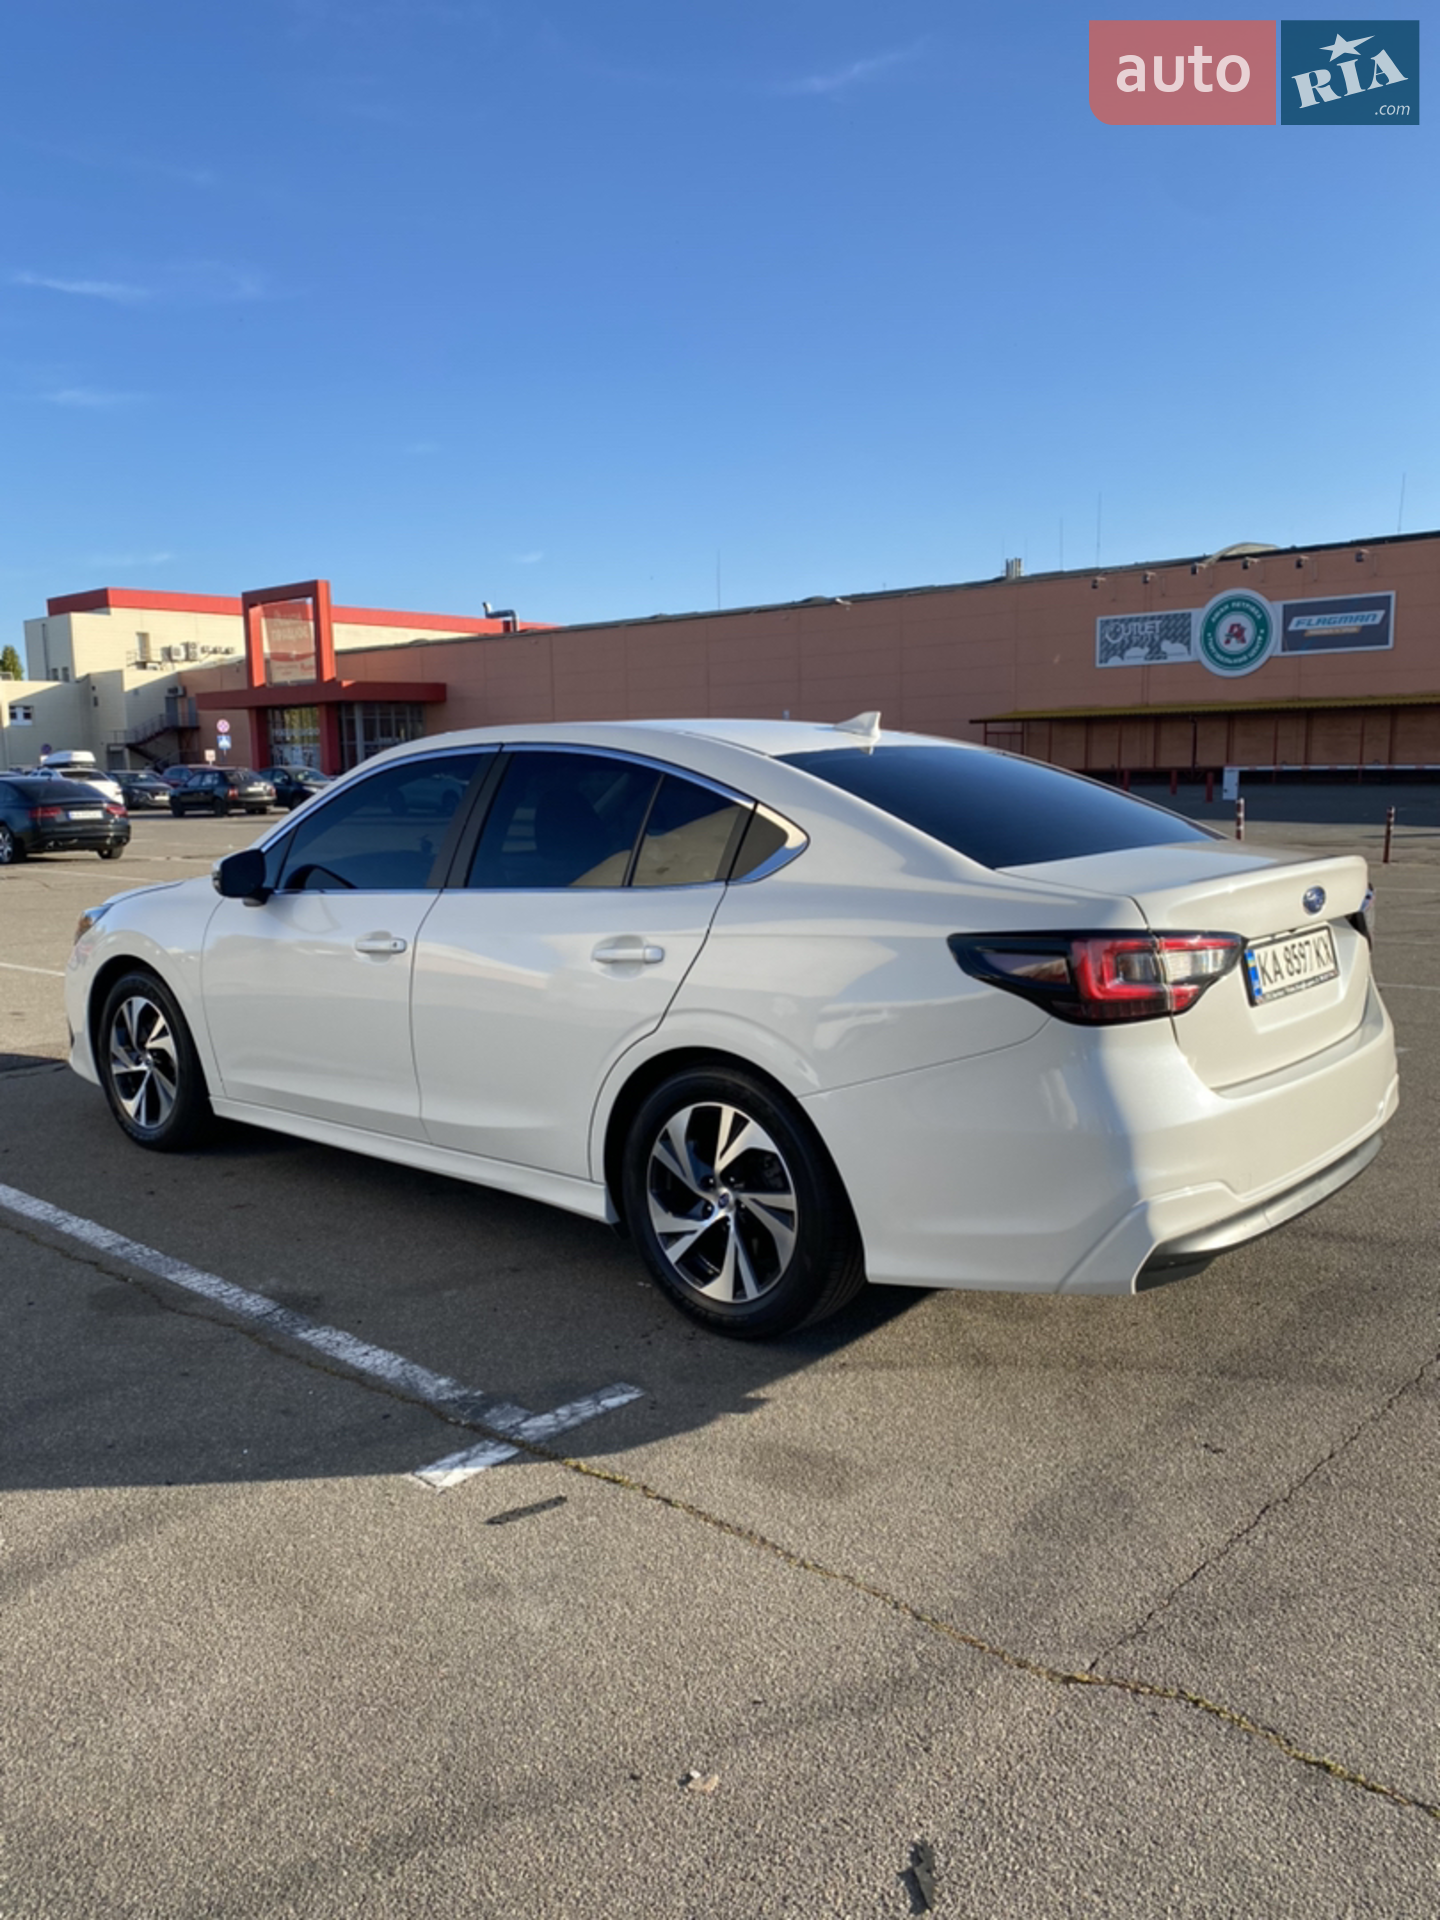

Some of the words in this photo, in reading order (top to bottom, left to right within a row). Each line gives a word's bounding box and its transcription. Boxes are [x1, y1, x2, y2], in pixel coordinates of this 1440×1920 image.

[1105, 620, 1162, 644] OUTLET
[1295, 613, 1378, 628] FLAGMAN
[1257, 950, 1285, 987] KA
[1283, 940, 1313, 977] 8597
[1312, 935, 1333, 970] KX
